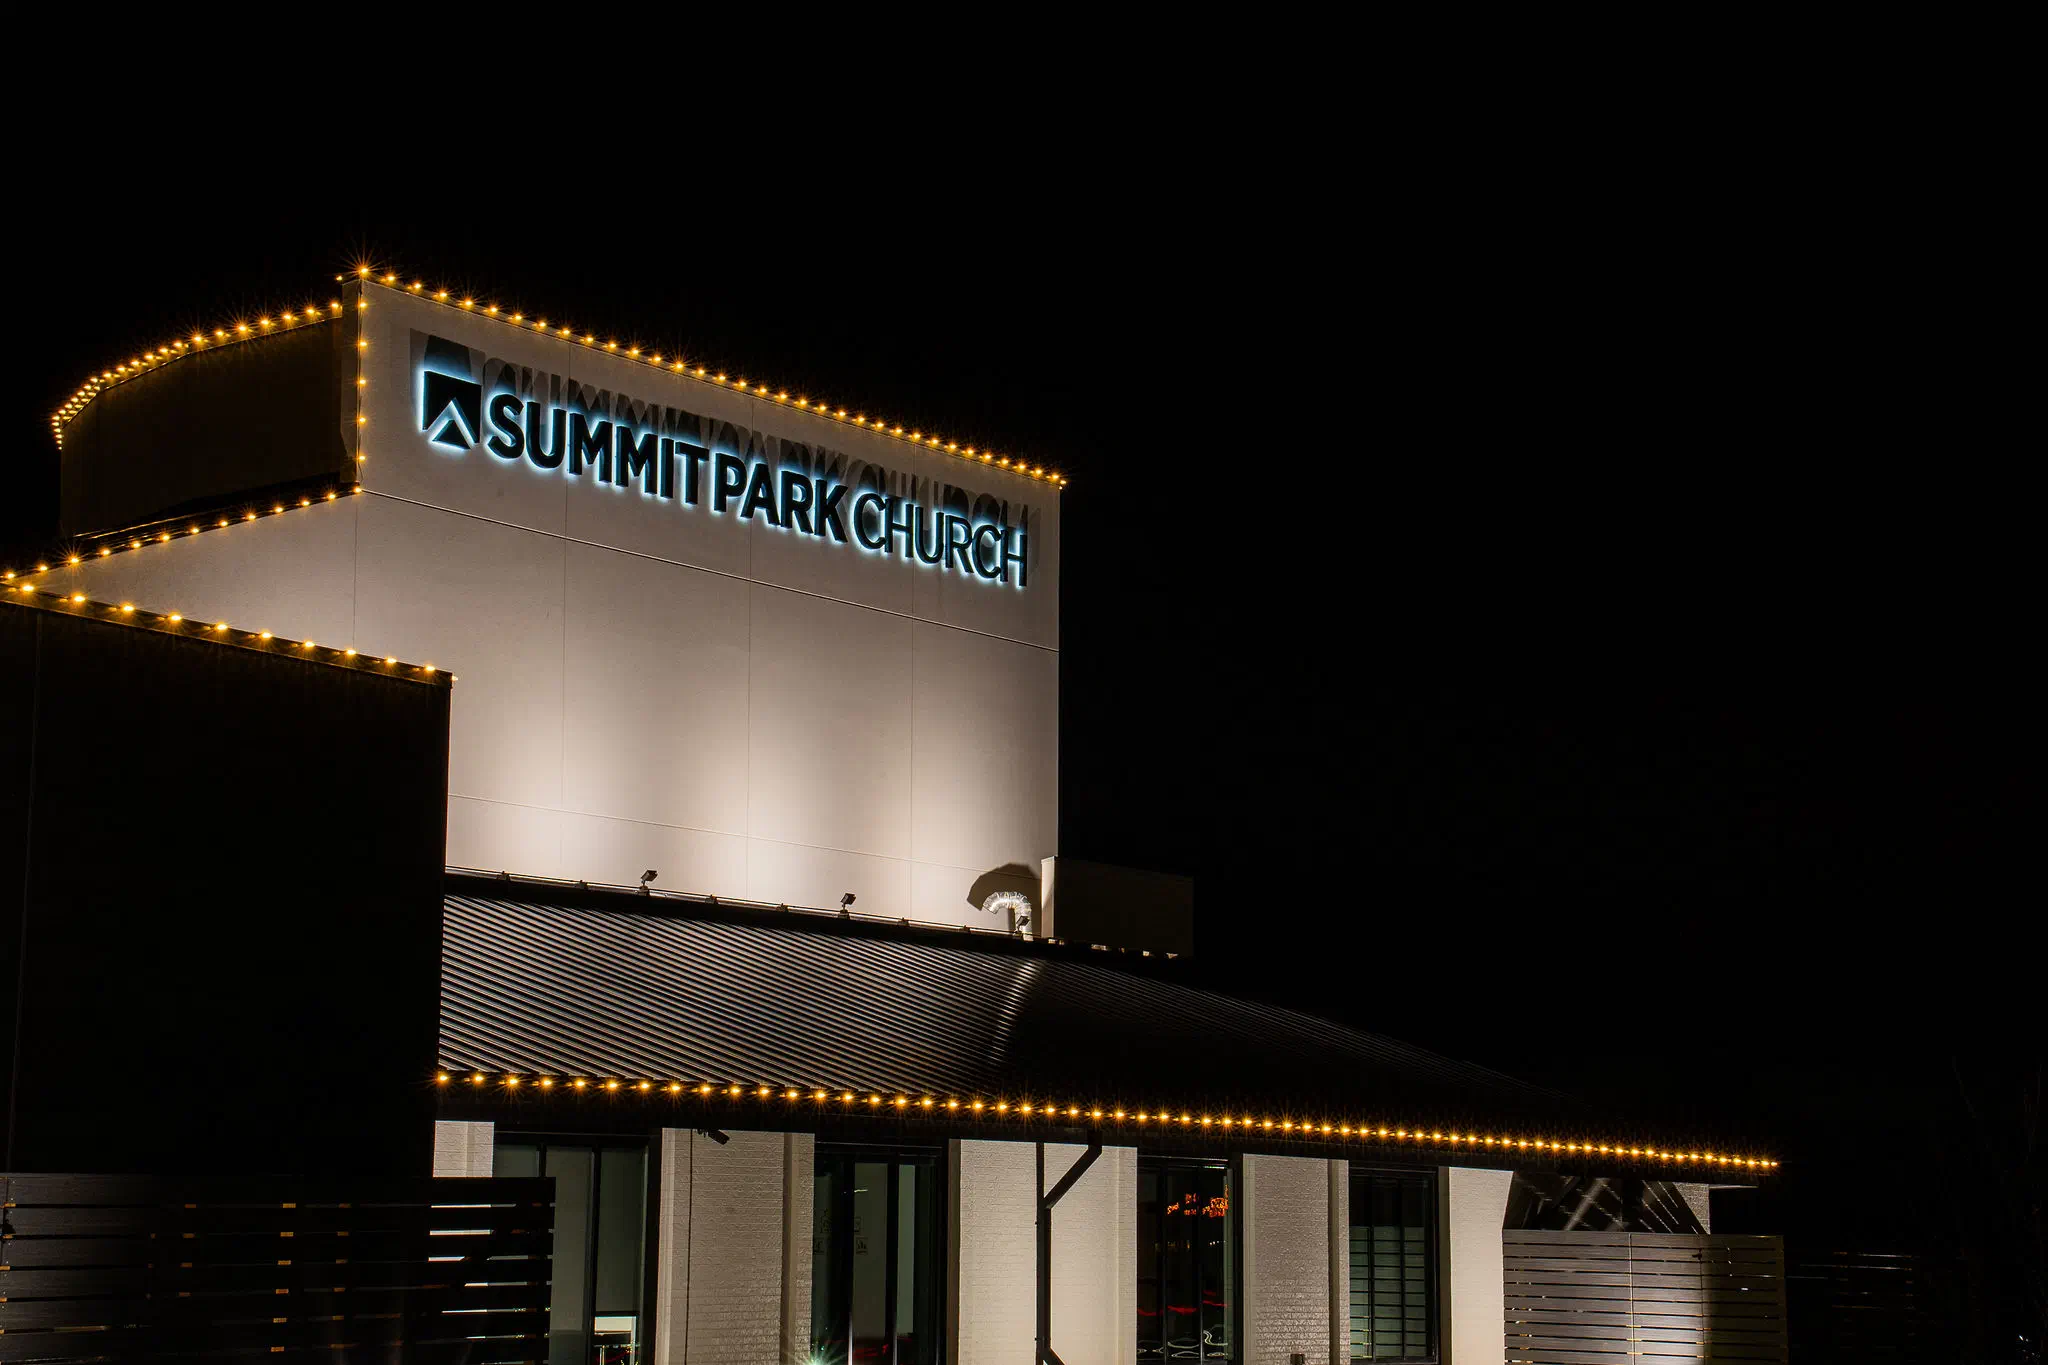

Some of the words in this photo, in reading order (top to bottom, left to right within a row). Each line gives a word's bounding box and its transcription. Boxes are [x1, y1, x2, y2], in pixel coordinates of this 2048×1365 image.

[487, 393, 710, 505] SUMMIT
[713, 452, 849, 543] PARK
[853, 492, 1028, 587] CHURCH
